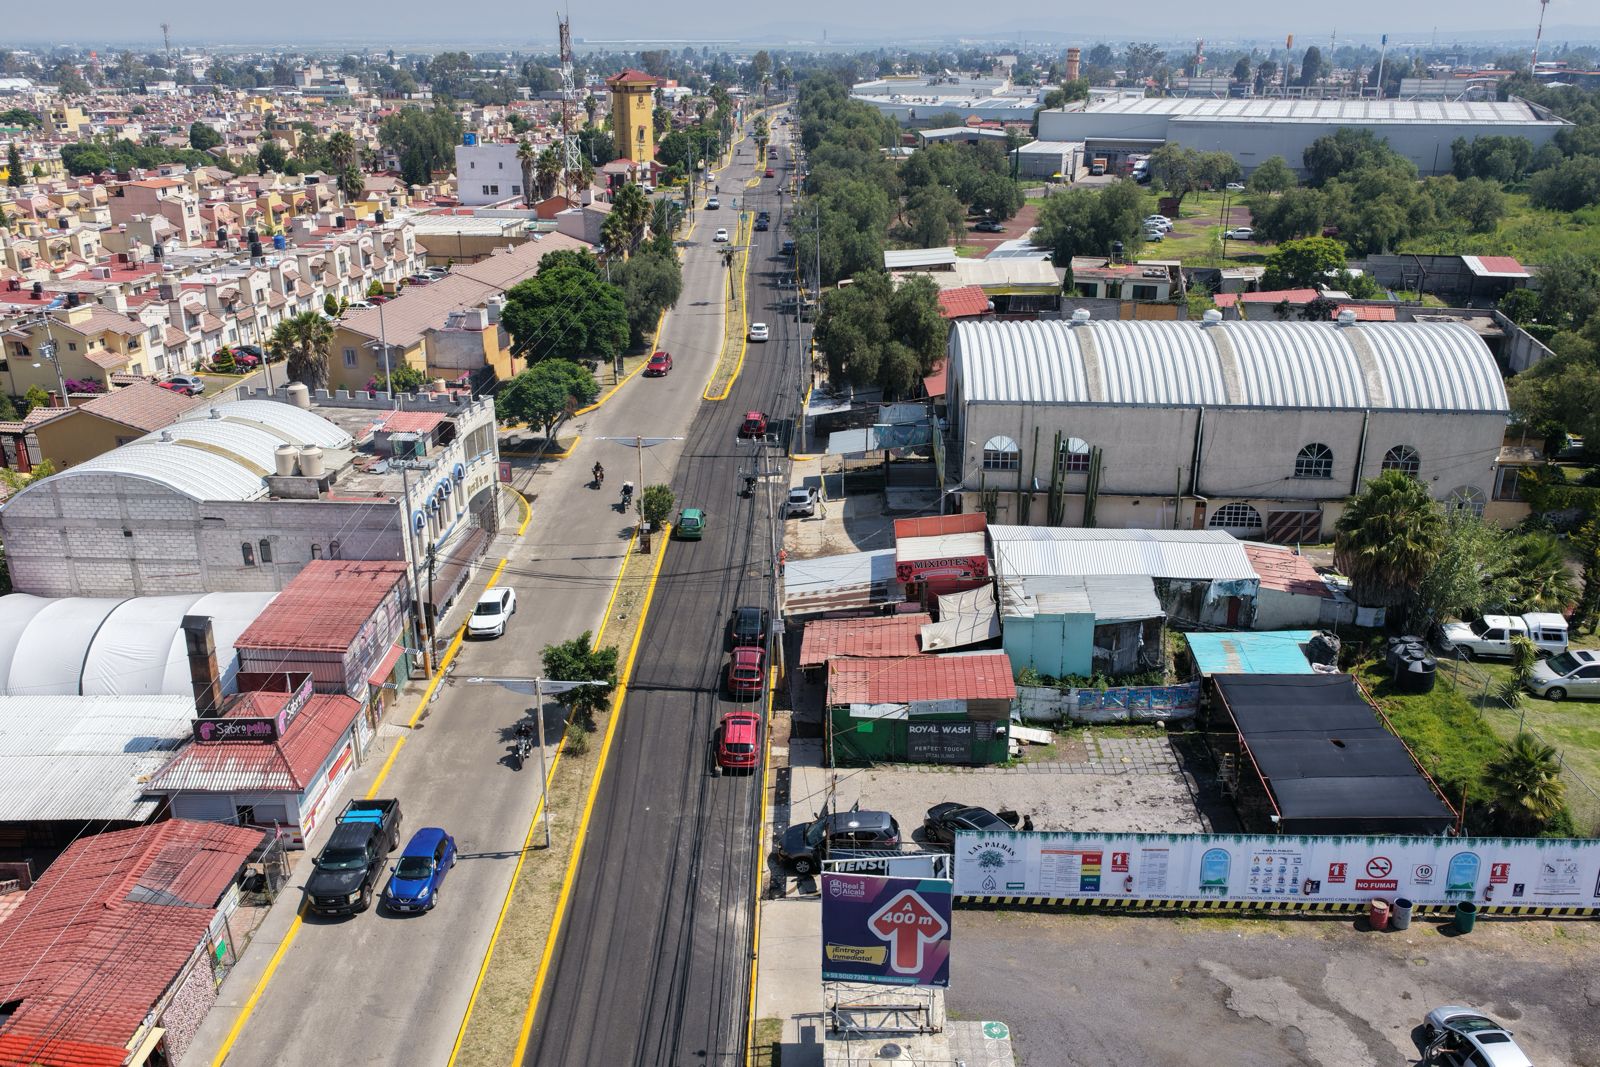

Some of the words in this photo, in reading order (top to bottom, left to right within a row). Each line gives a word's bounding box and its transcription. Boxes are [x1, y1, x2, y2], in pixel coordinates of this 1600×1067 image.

[913, 558, 969, 569] MIXIOTES
[909, 725, 939, 733] ROYAL
[942, 726, 971, 734] WASH
[968, 844, 983, 855] LAS
[984, 841, 1016, 856] PALMAS
[1420, 867, 1430, 875] 10
[902, 902, 912, 911] A
[882, 912, 916, 924] 400
[918, 916, 933, 925] m
